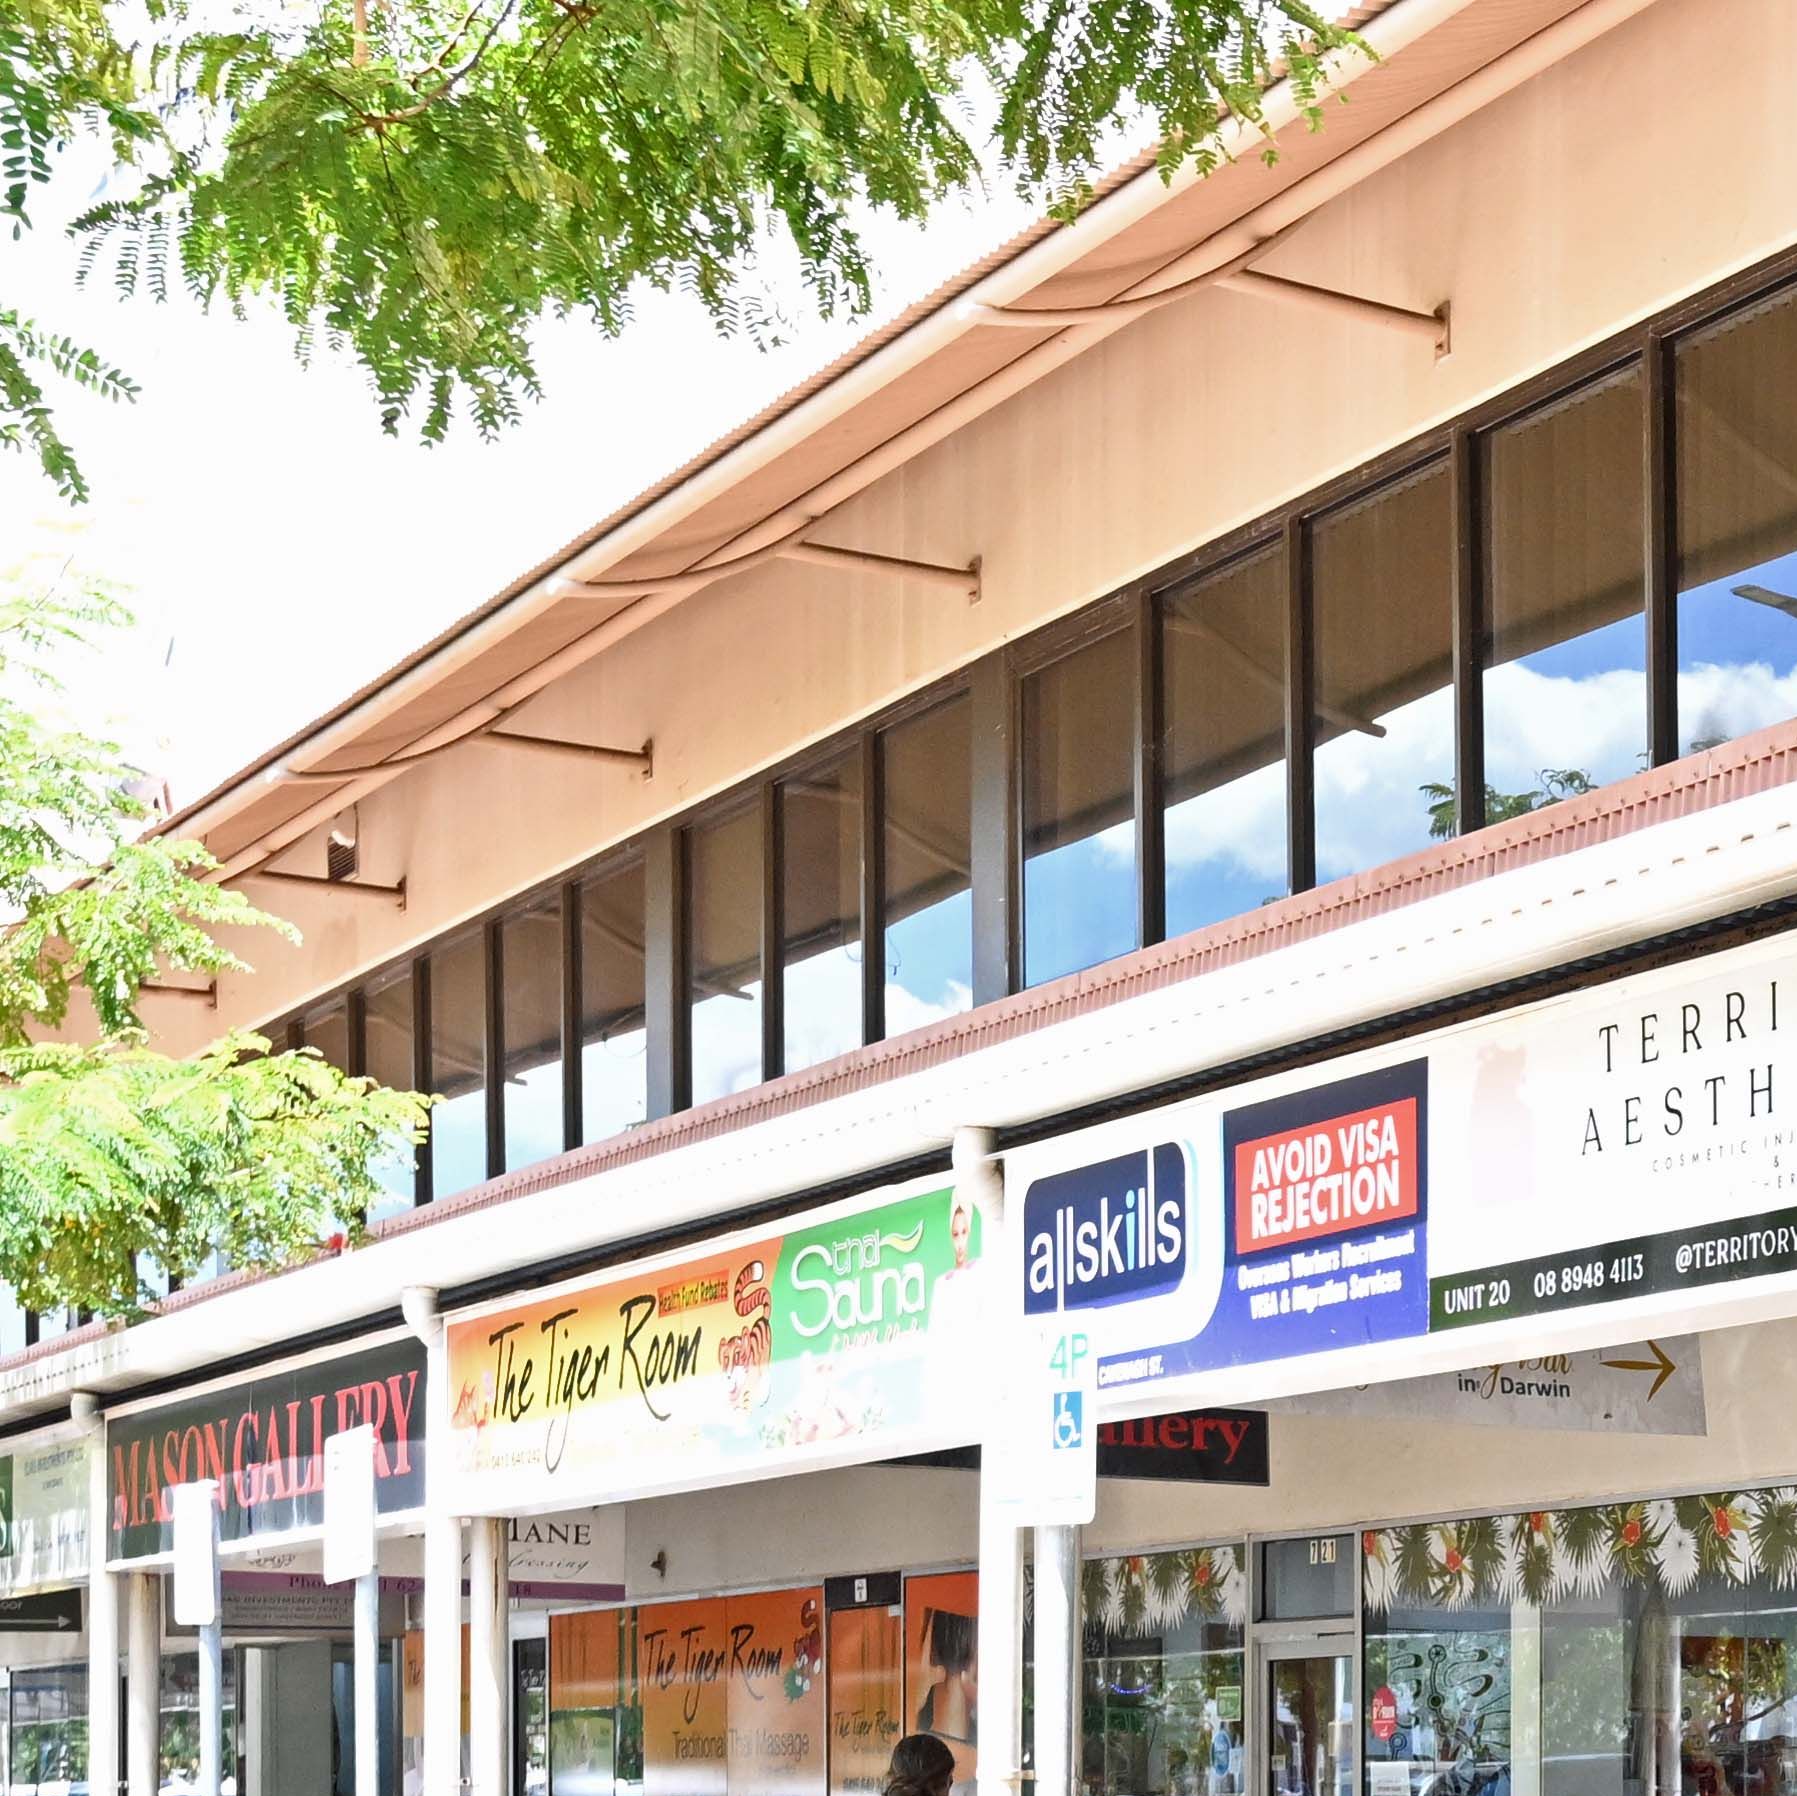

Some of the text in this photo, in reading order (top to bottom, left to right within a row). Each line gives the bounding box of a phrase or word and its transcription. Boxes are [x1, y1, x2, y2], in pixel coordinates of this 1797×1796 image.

[1252, 1115, 1398, 1191] AVOID VISA
[1653, 1141, 1747, 1172] COSMETIC
[1029, 1147, 1183, 1311] allskills
[1252, 1159, 1399, 1239] REJECTION
[790, 1245, 926, 1337] Sauna
[1443, 1282, 1485, 1315] UNIT
[1489, 1278, 1511, 1308] 20
[1533, 1271, 1557, 1299] 08
[1561, 1260, 1605, 1294] 8948
[1610, 1253, 1644, 1285] 4113
[489, 1294, 701, 1473] The Tiger Room
[1050, 1333, 1088, 1379] 4P
[1458, 1374, 1474, 1393] in
[1500, 1376, 1571, 1398] Darwin
[113, 1418, 229, 1530] MASON
[644, 1623, 782, 1724] The Tiger Room
